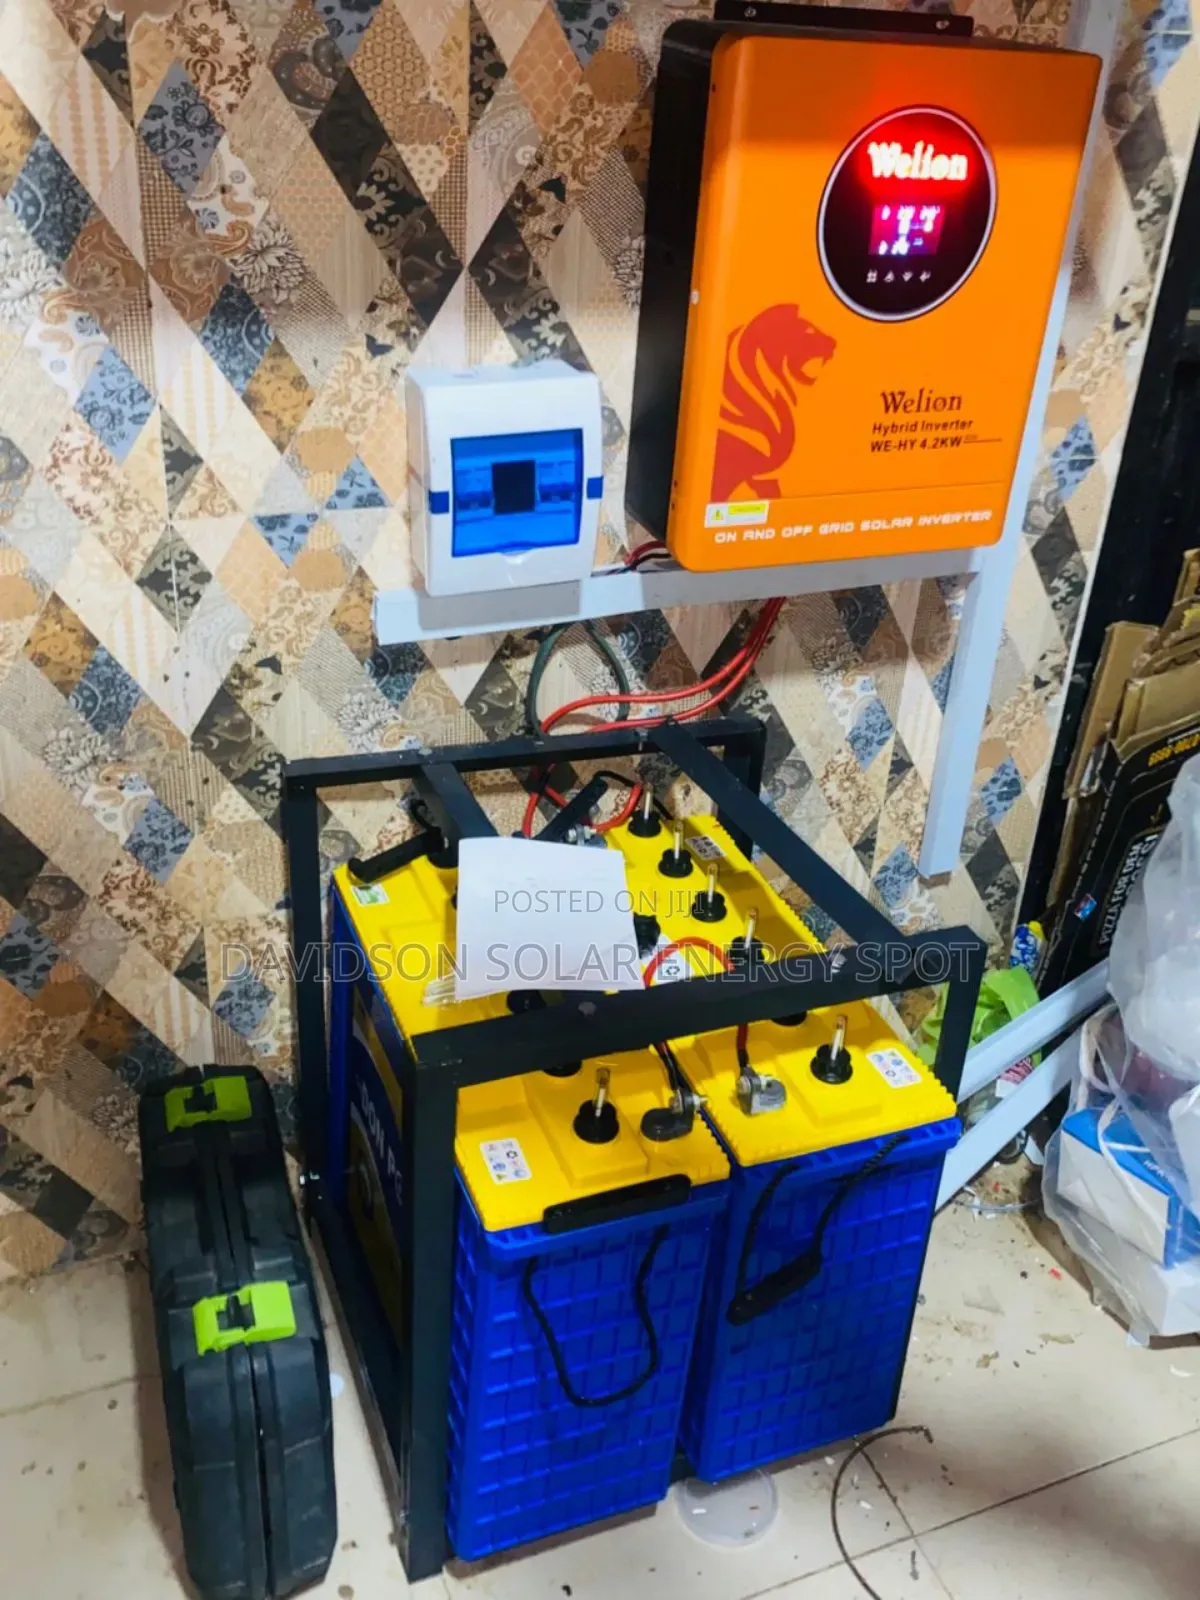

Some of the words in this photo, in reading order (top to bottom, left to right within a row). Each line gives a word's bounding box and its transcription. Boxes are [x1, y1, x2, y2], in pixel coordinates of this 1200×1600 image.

[867, 140, 968, 180] Welion
[880, 387, 962, 414] Welion
[872, 421, 918, 437] Hybrid
[921, 419, 974, 433] Inverter
[870, 439, 917, 453] WE-HY
[919, 436, 962, 450] 4.2KW
[714, 531, 737, 543] ON
[743, 528, 776, 541] AND
[782, 525, 812, 538] OFF
[819, 522, 855, 535] GRID
[860, 517, 913, 531] SOLAR
[918, 509, 993, 527] INVERTER
